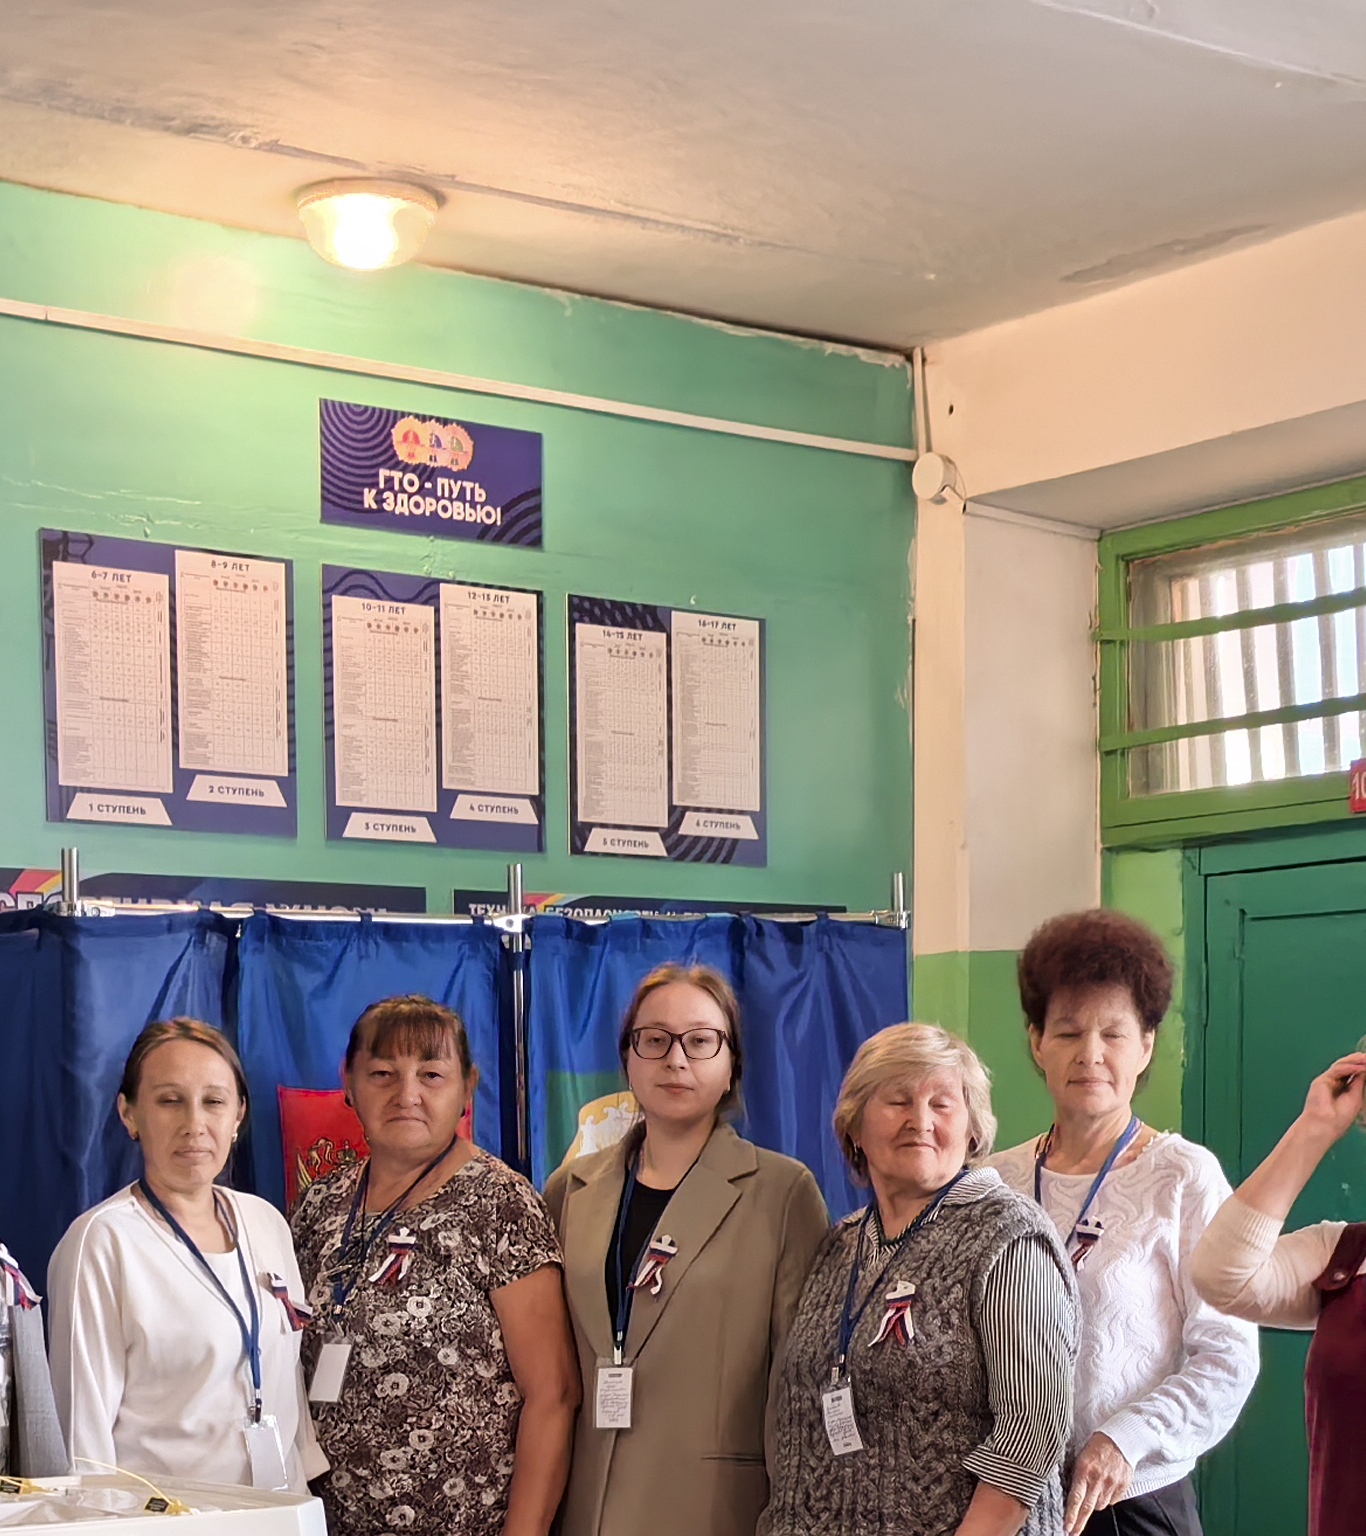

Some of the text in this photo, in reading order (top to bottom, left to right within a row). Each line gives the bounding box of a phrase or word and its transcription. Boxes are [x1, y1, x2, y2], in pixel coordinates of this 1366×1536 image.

[378, 468, 420, 493] ГТО
[437, 477, 487, 502] ПУТЬ
[363, 487, 502, 526] К ЗДОРОВЬЮ!
[210, 560, 250, 571] 8-9 ЛЕТ
[91, 570, 132, 583] 6-7 ЛЕТ
[493, 594, 510, 604] ЛЕТ
[361, 602, 405, 615] 10-11 ЛЕТ
[721, 622, 737, 631] ЛЕТ
[627, 632, 643, 641] ЛЕТ
[218, 786, 265, 797] СТУПЕНЬ
[97, 804, 146, 815] СТУПЕНЬ
[478, 804, 519, 815] СТУПЕНЬ
[372, 823, 416, 833] СТУПЕНЬ
[703, 820, 741, 830] СТУПЕНЬ
[610, 838, 649, 848] СТУПЕНЬ
